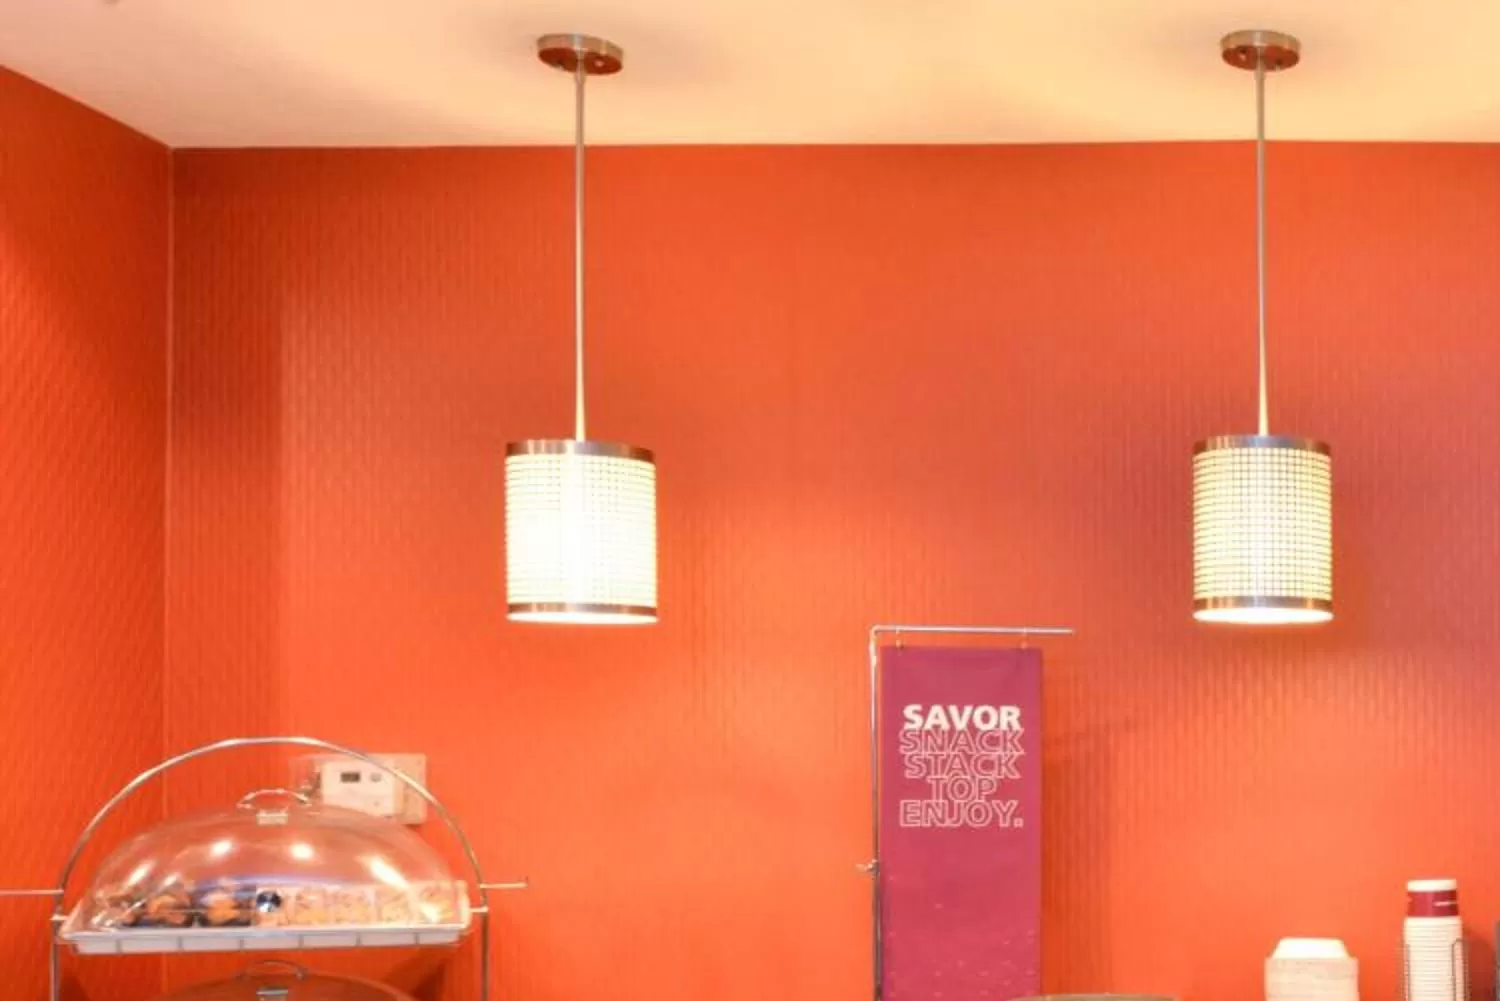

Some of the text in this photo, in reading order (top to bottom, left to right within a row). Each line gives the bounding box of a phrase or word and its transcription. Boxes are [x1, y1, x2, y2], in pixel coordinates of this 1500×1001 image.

[903, 704, 1021, 730] SAVOR
[899, 728, 1025, 754] SNACK
[904, 752, 1021, 779] STACK
[926, 775, 998, 802] TOP
[900, 799, 1024, 827] ENJOY.
